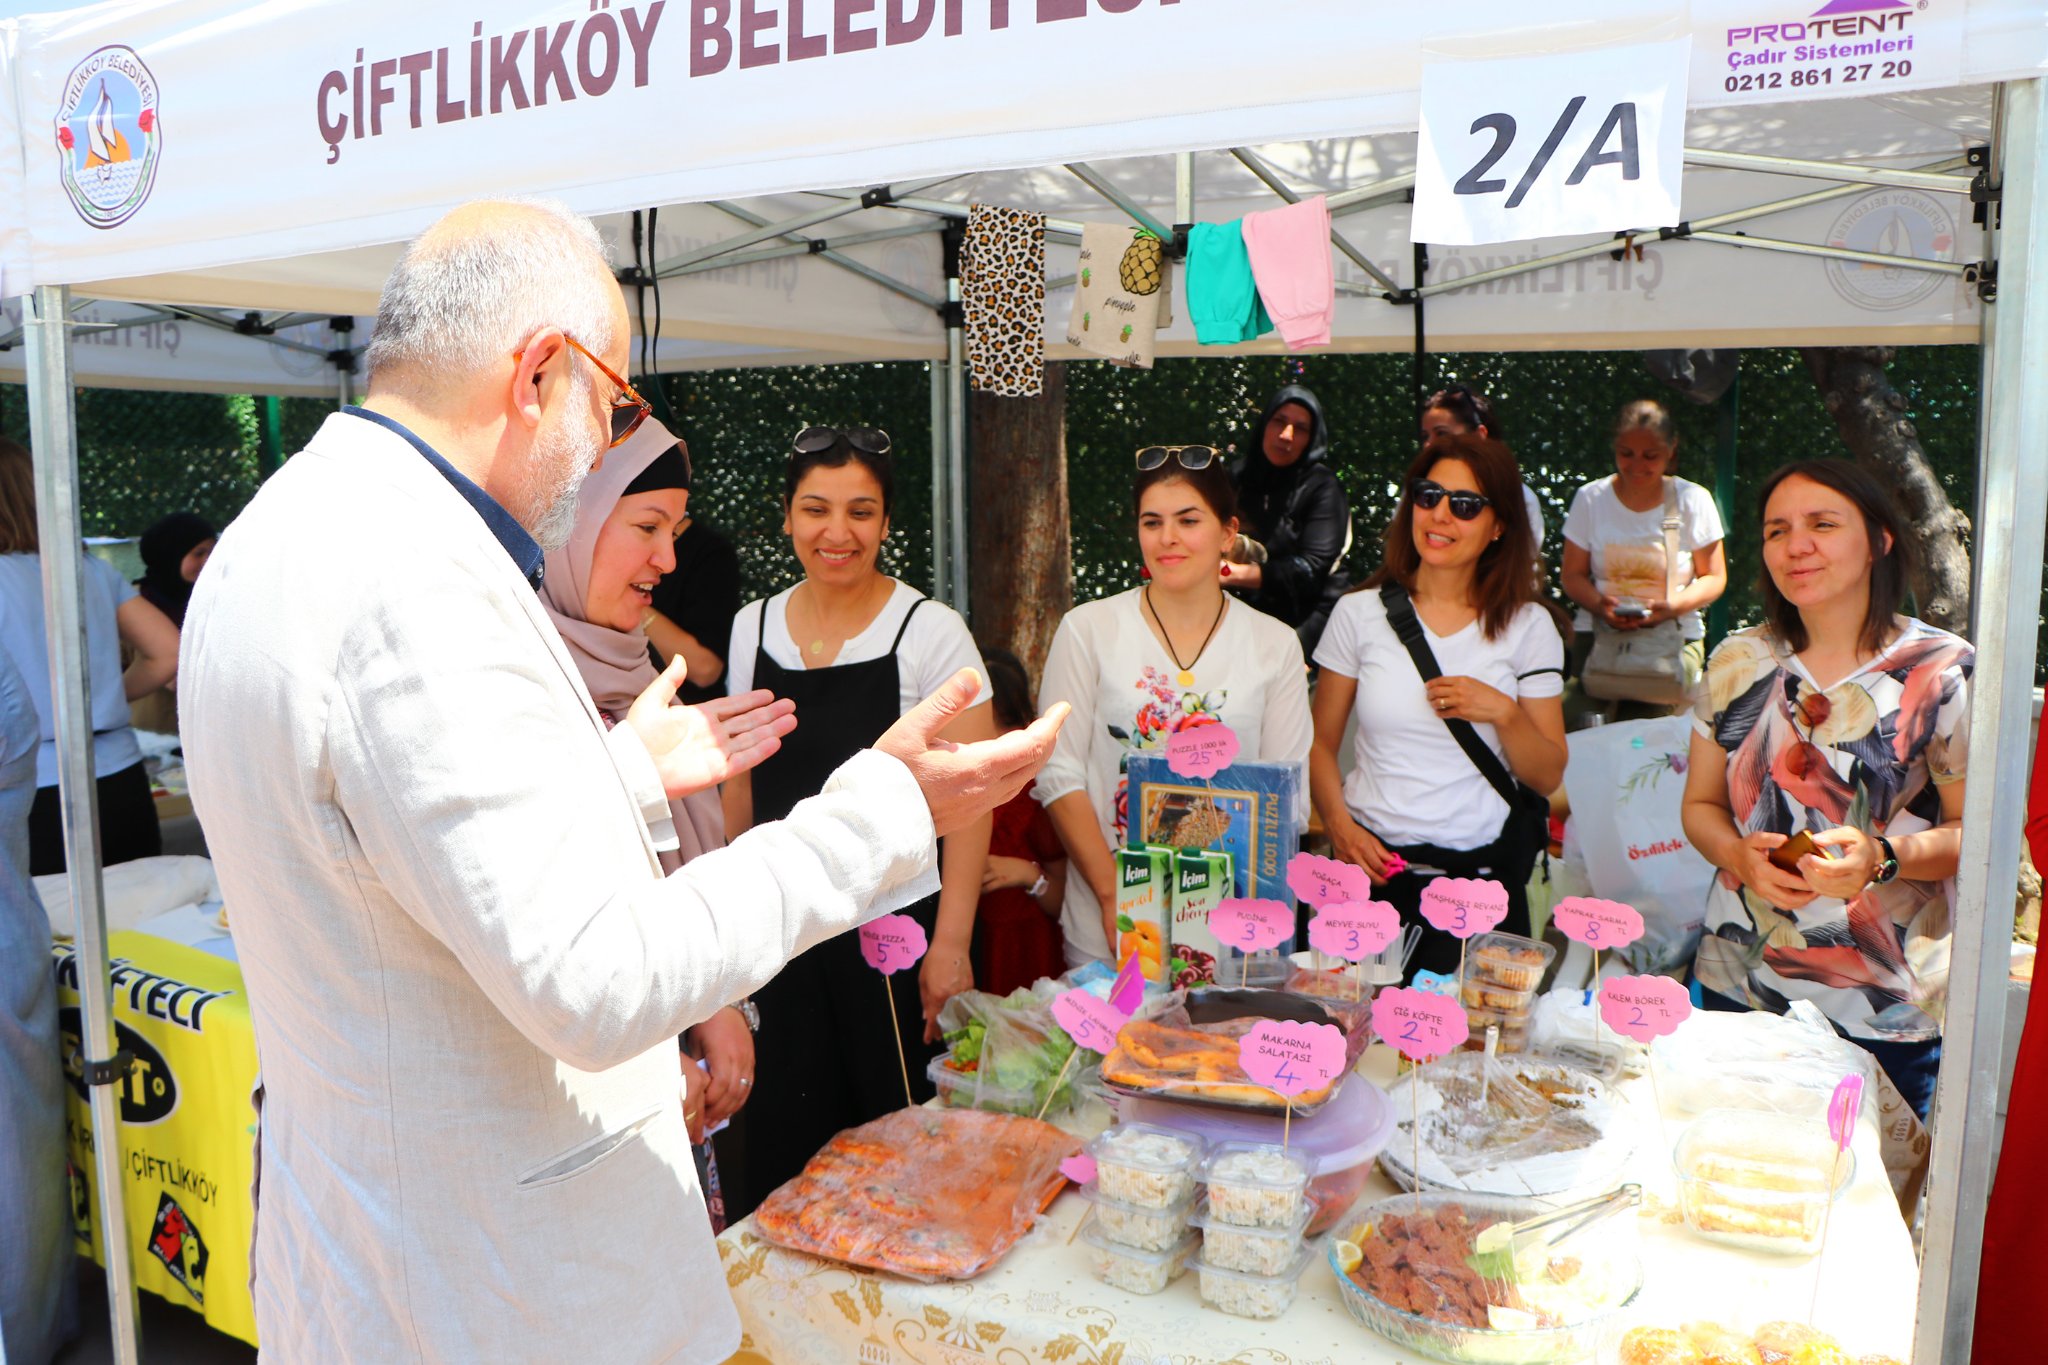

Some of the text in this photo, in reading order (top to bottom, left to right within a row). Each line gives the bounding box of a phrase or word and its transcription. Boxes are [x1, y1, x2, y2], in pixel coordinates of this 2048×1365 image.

[1727, 11, 1914, 47] PROTENT
[1727, 35, 1914, 71] Çadır Sistemleri
[317, 0, 667, 165] ÇİFTLİKKÖY
[1724, 60, 1913, 93] 0212 861 27 20
[1453, 96, 1641, 209] 2/A
[1172, 744, 1197, 754] PUZZLE
[1201, 741, 1217, 750] 1000
[1188, 751, 1212, 765] 25
[1263, 792, 1280, 877] PUZZLE 1000
[1125, 864, 1149, 882] İçim
[1181, 870, 1206, 888] İçim
[1312, 869, 1341, 887] POĞAÇA
[1319, 885, 1350, 899] 3 TL
[1325, 919, 1380, 929] MEYVE SUYU
[1451, 907, 1467, 929] 3
[1598, 915, 1627, 925] SARMA
[1241, 922, 1256, 941] 3
[1585, 921, 1600, 940] 8
[1345, 930, 1360, 951] 3
[877, 943, 891, 963] 5
[1607, 992, 1666, 1005] KALEM BÖREK
[1413, 1011, 1443, 1025] KÖFTE
[1627, 1007, 1671, 1026] 2 TL
[1074, 1019, 1096, 1038] 5
[1399, 1021, 1440, 1043] 2 TL
[1260, 1033, 1312, 1050] MAKARNA
[1258, 1045, 1312, 1063] SALATASI
[1274, 1060, 1329, 1086] 4 TL
